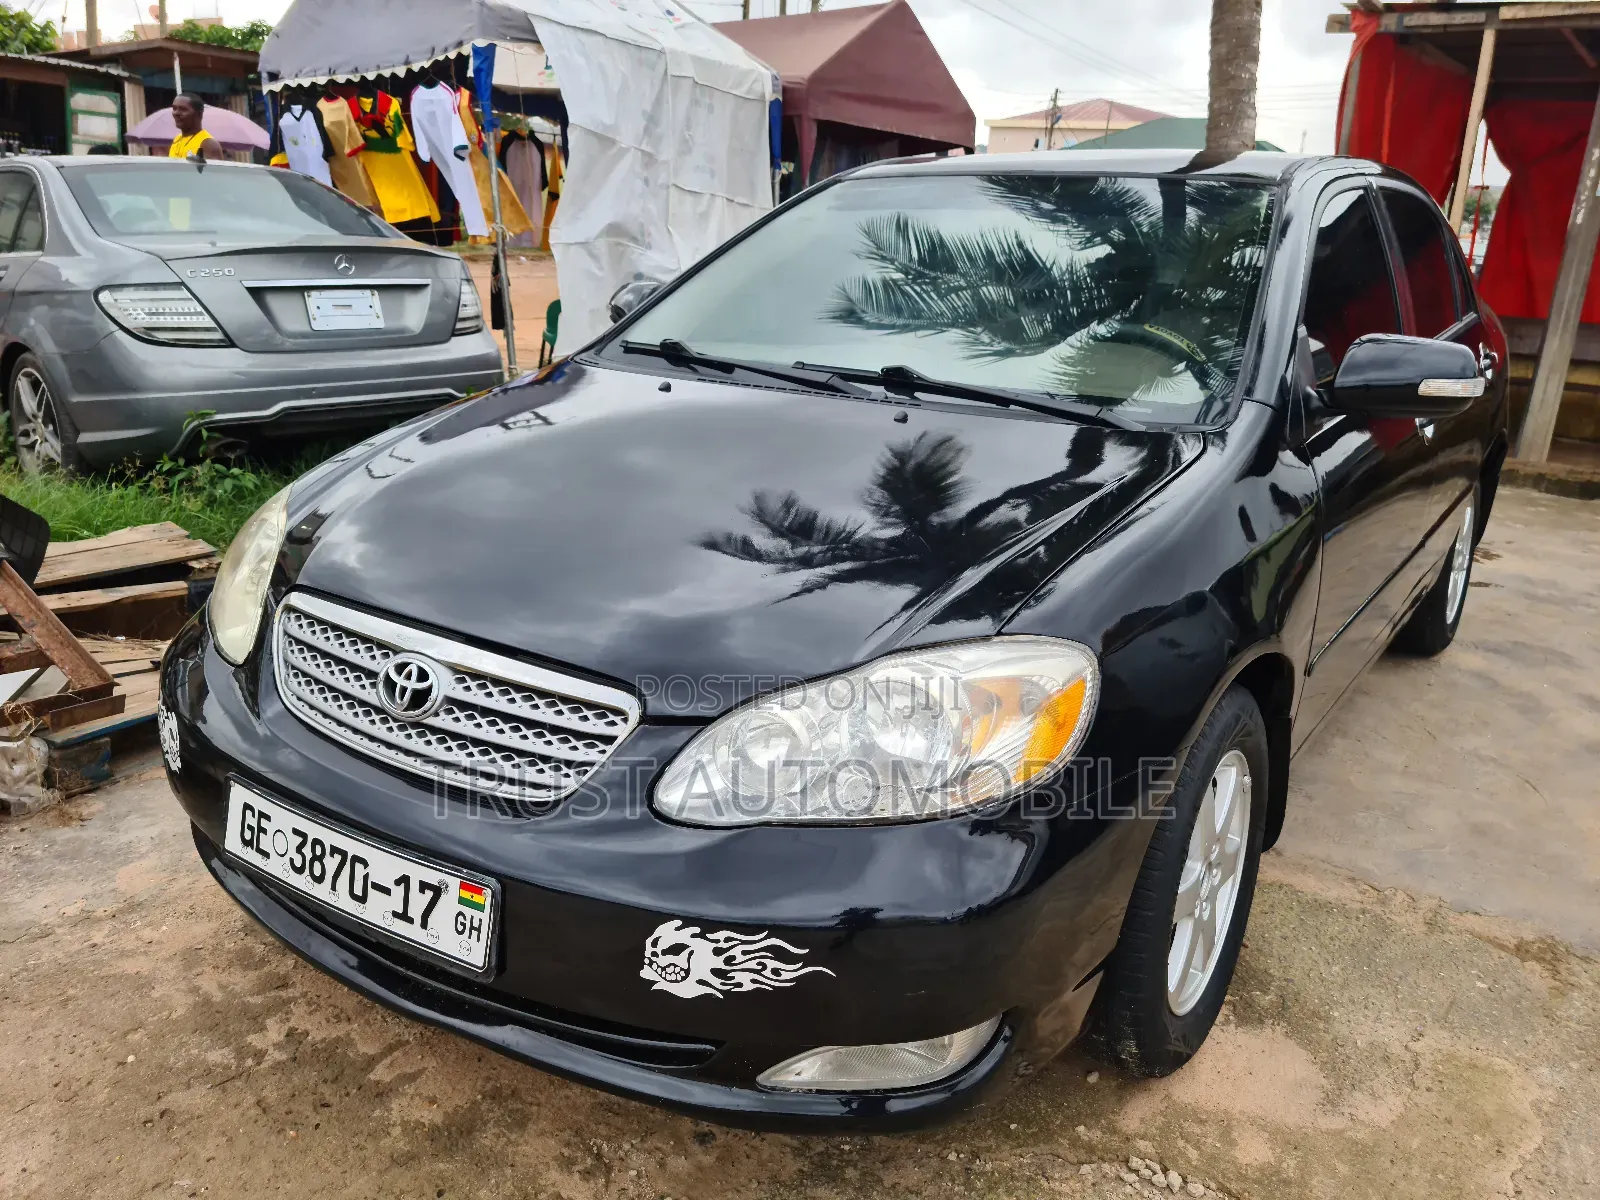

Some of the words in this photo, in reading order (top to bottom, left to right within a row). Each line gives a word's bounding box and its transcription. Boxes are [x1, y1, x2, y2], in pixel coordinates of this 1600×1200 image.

[187, 269, 197, 278] C
[201, 268, 235, 277] 250
[240, 801, 272, 860] GE
[289, 827, 443, 931] 3870-17
[454, 910, 483, 943] GH
